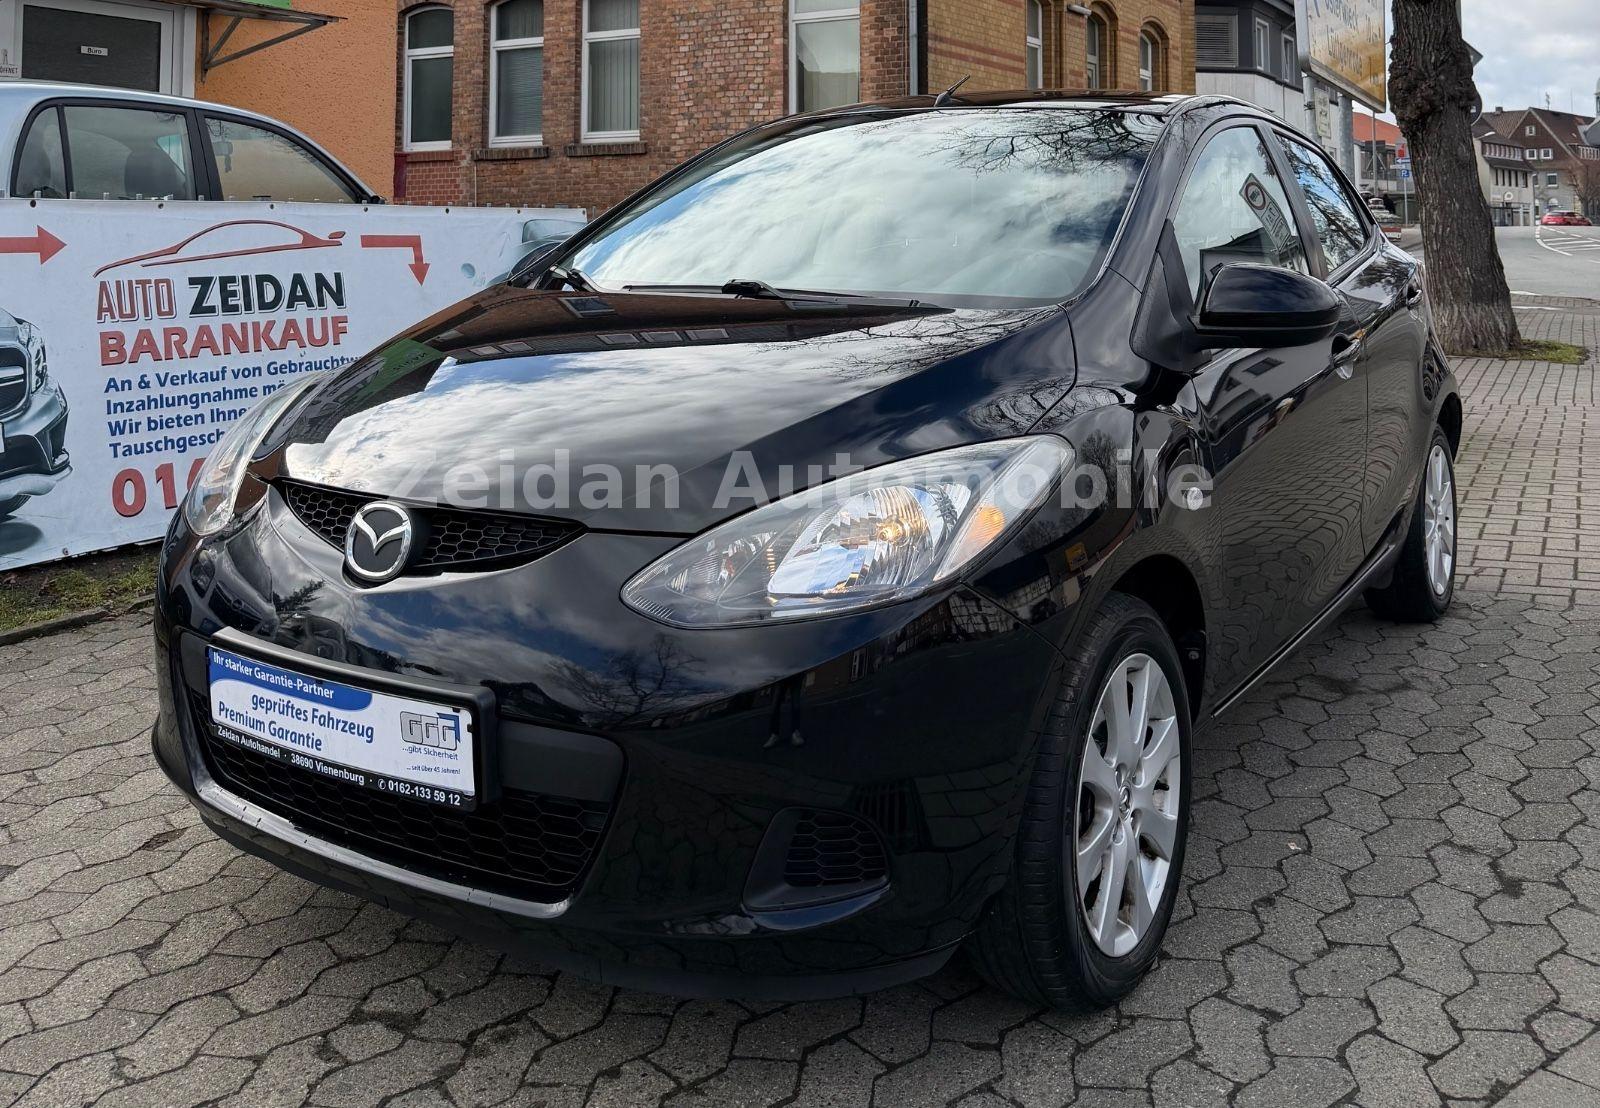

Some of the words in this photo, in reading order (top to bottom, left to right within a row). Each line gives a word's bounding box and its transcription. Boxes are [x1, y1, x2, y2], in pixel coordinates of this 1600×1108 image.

[97, 278, 177, 323] AUTO
[188, 272, 347, 318] ZEIDAN
[100, 316, 349, 366] BARANKAUF
[104, 377, 132, 393] An
[138, 374, 151, 389] &
[155, 366, 227, 388] Verkauf
[231, 366, 262, 380] von
[106, 386, 258, 415] Inzahlungnahme
[108, 419, 141, 436] Wir
[147, 413, 205, 431] bieten
[210, 407, 251, 423] Ihne
[213, 652, 224, 666] Ihr
[225, 657, 252, 676] starker
[254, 668, 334, 699] Garantie-Partner
[219, 701, 266, 733] Premium
[268, 721, 322, 751] Garantie
[251, 694, 308, 722] geprüftes
[311, 708, 374, 743] Fahrzeug
[218, 726, 240, 743] Zeidan
[240, 735, 281, 758] Autohandel
[291, 753, 314, 769] 38690
[315, 760, 364, 786] Vienenburg
[388, 780, 431, 799] 0162-133
[433, 790, 446, 803] 59
[448, 793, 461, 806] 12
[424, 747, 458, 760] Sicherheit
